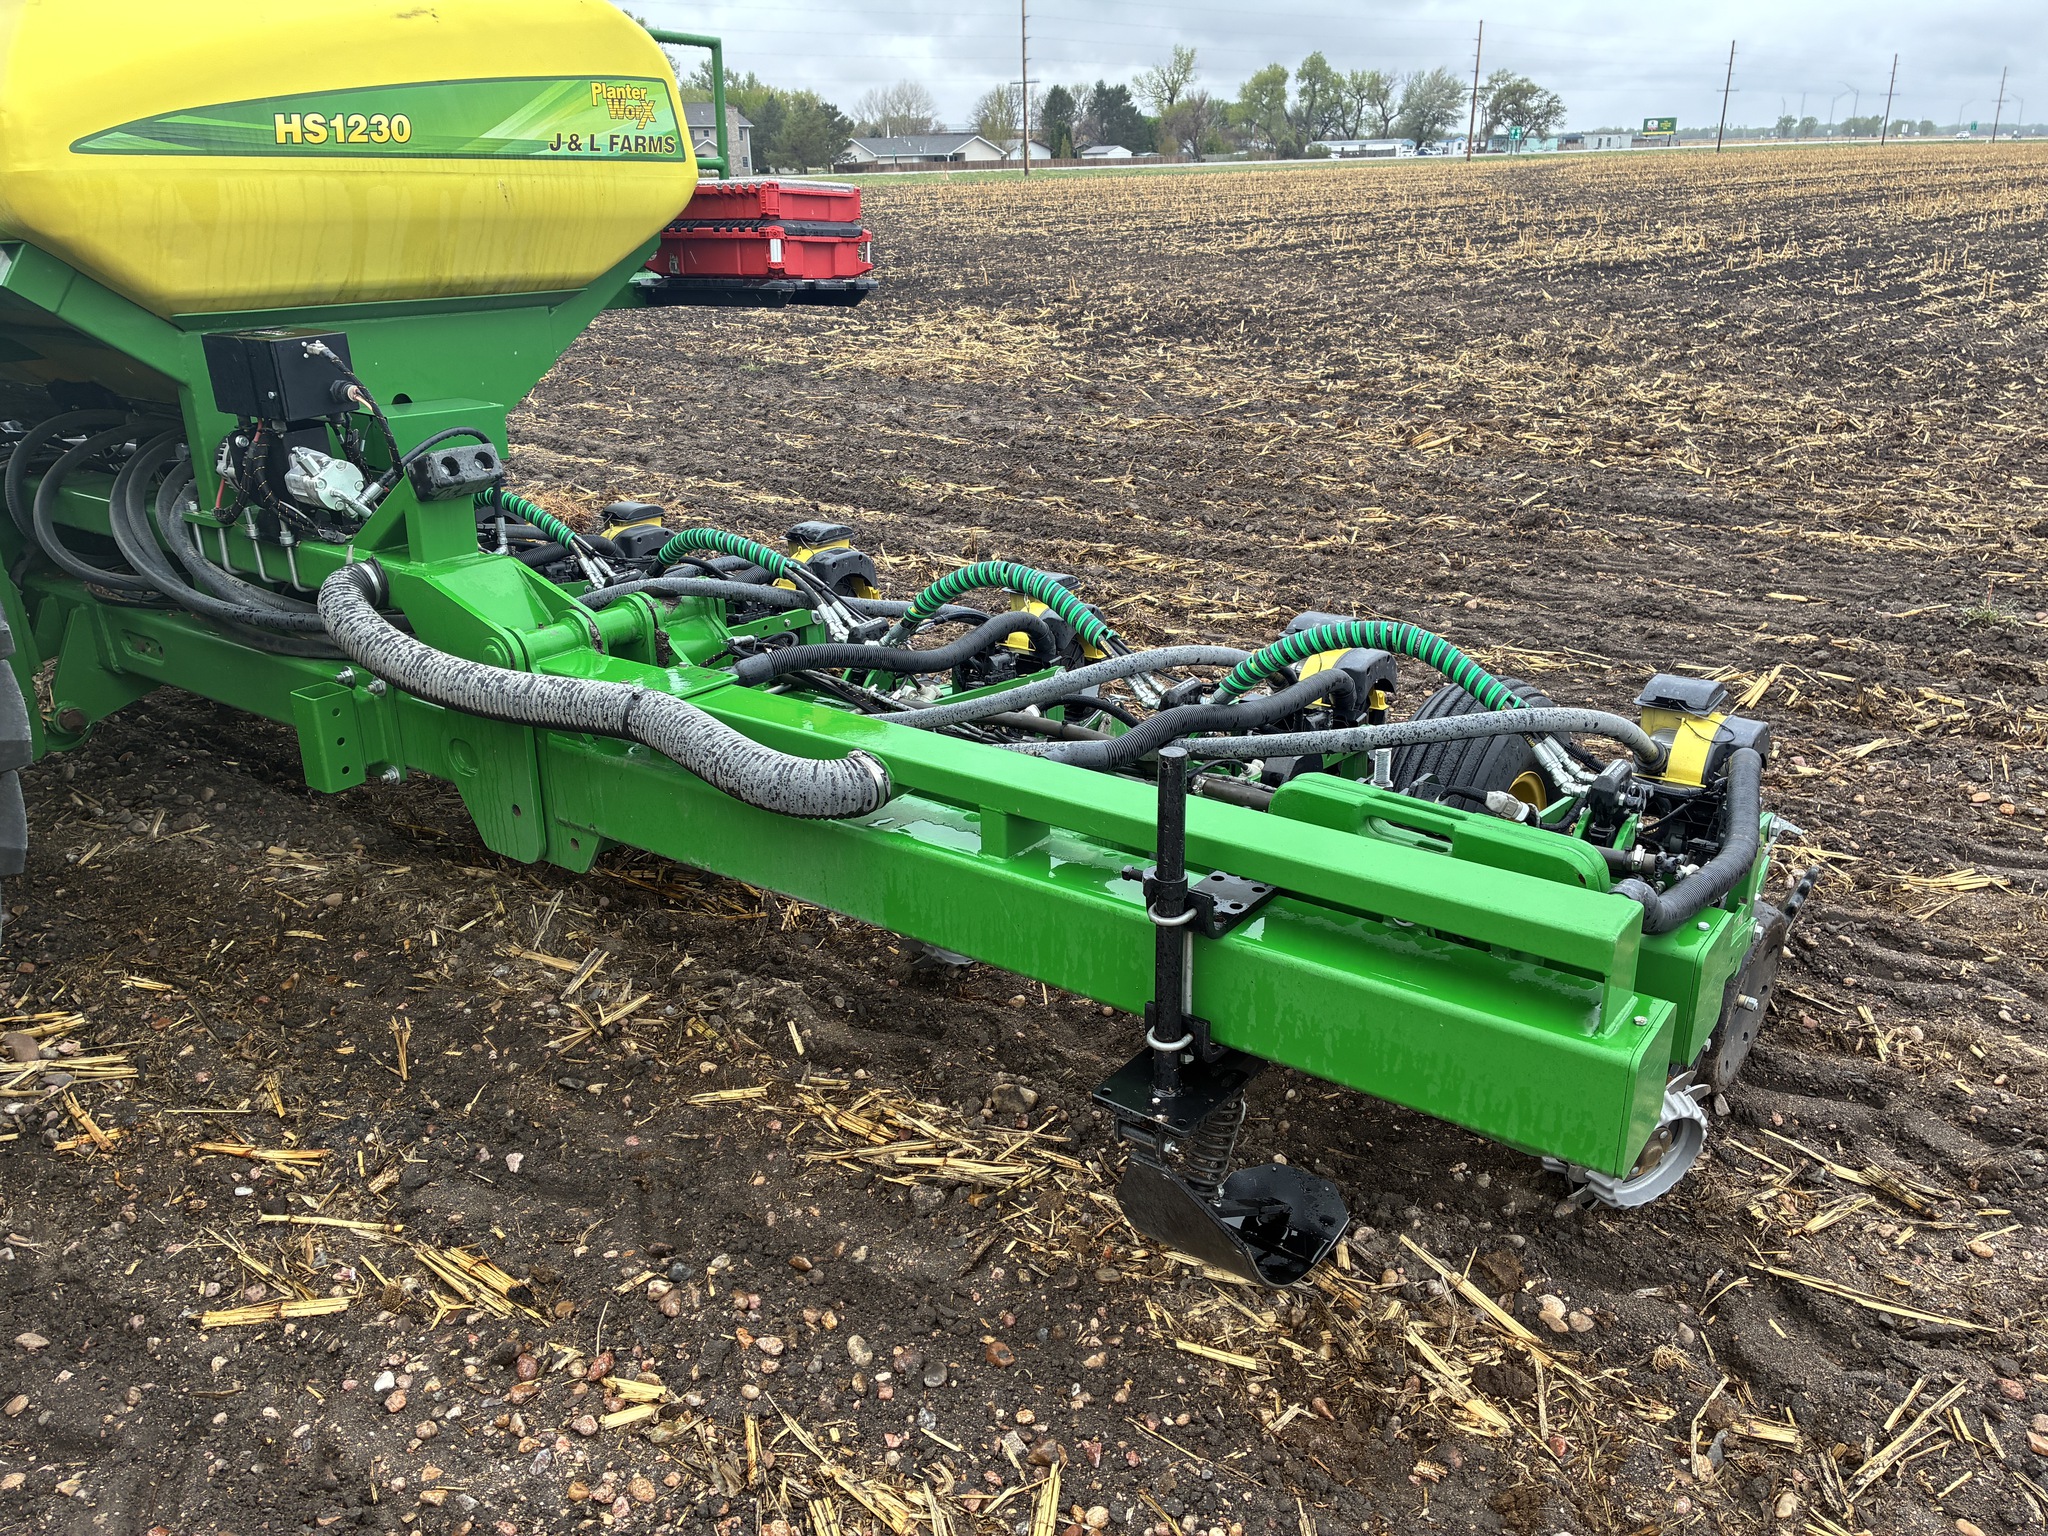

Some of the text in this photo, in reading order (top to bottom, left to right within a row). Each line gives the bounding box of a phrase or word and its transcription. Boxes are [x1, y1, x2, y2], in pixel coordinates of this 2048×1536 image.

[590, 81, 647, 107] Planter
[274, 112, 412, 144] HS1230
[606, 99, 657, 130] WorX
[549, 133, 675, 153] J & L FARMS
